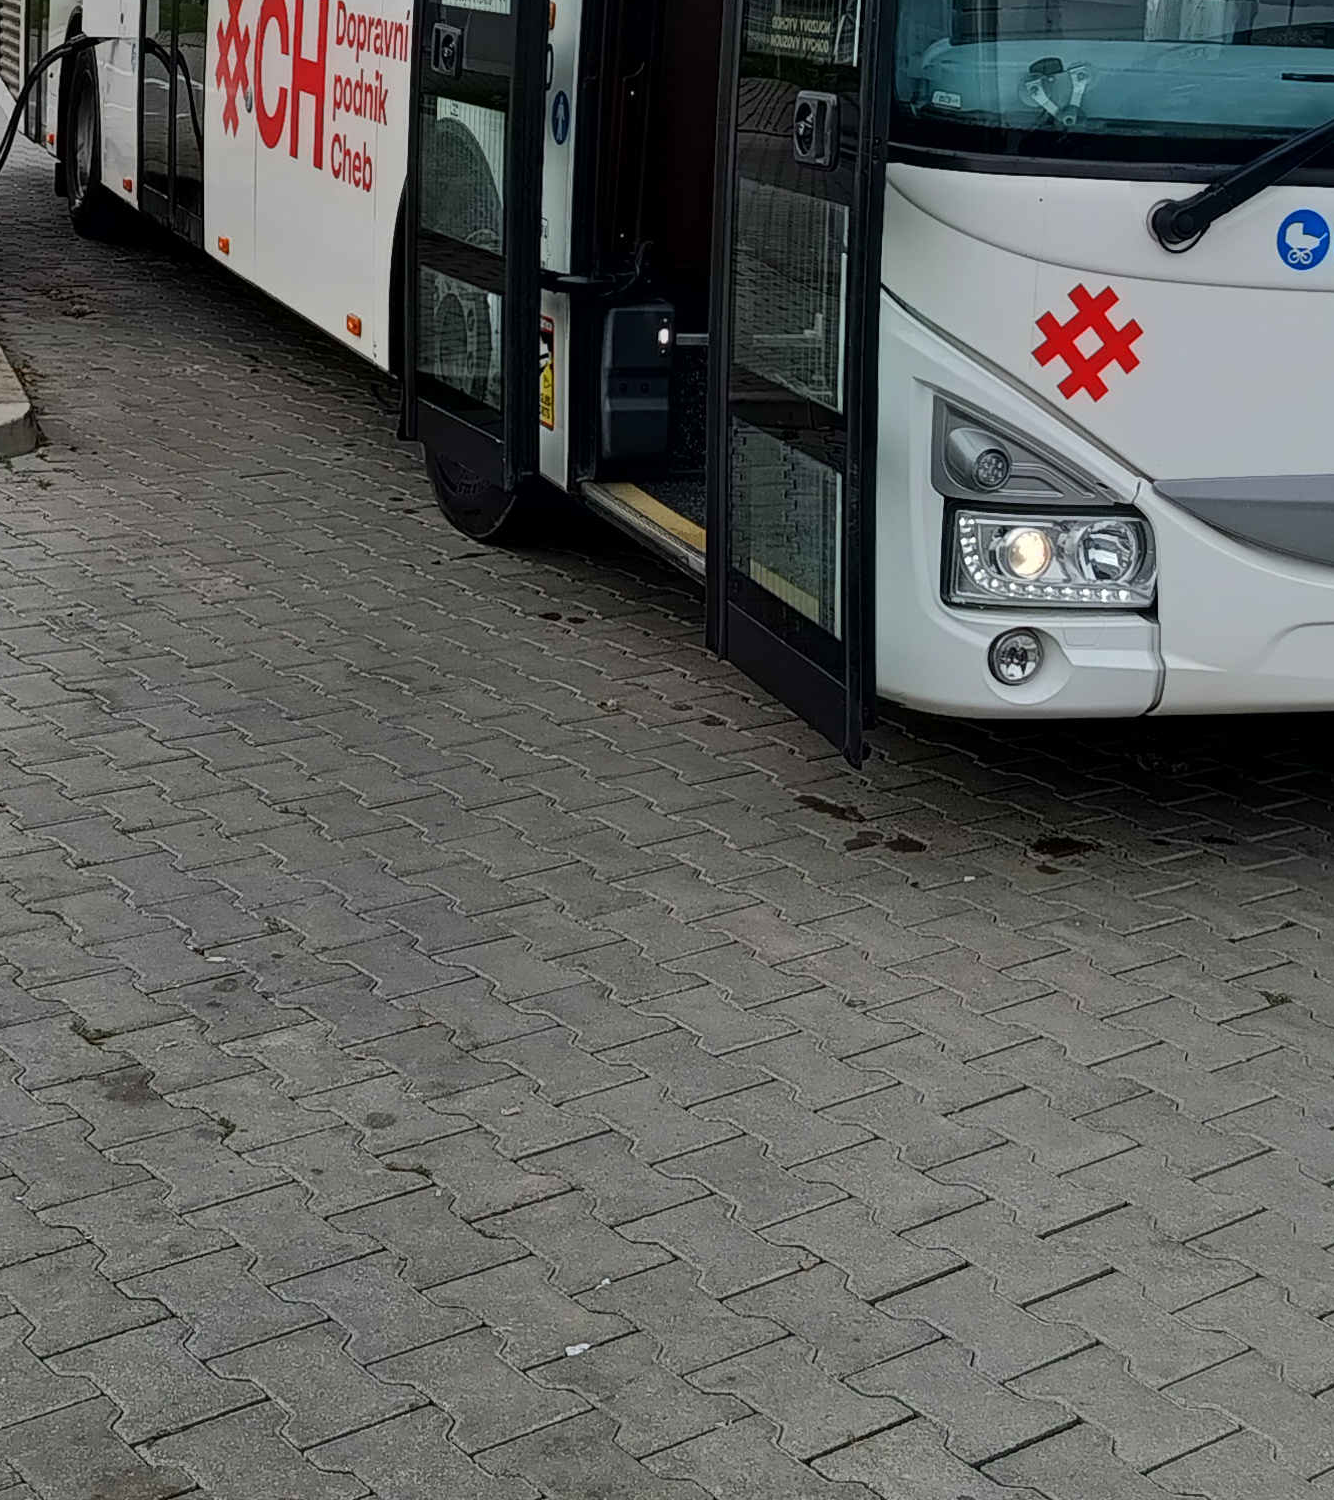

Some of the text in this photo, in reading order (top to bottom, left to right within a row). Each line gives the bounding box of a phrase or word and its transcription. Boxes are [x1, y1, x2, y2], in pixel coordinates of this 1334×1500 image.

[334, 0, 411, 64] Dopravní
[332, 68, 389, 126] podnik
[330, 132, 373, 193] Cheb
